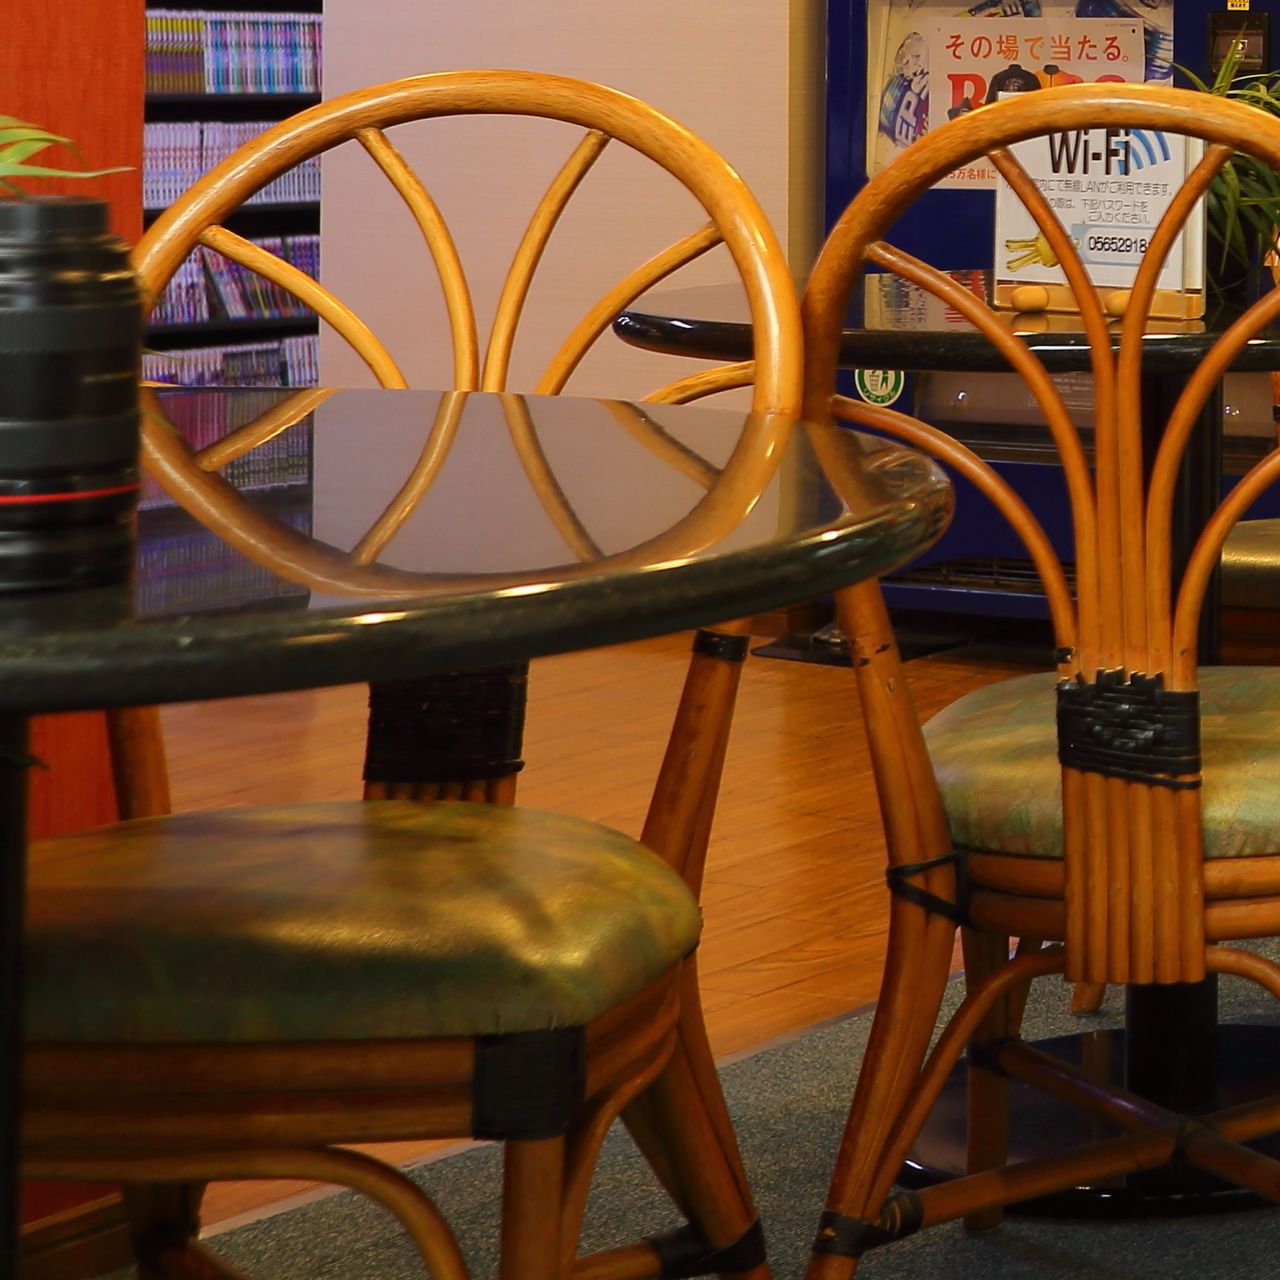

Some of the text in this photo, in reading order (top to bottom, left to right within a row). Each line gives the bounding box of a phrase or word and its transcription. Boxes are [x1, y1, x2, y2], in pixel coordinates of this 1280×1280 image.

[945, 33, 1130, 62] その場で当たる。
[1049, 129, 1131, 176] Wi-Fi
[1088, 236, 1151, 254] 05652918
